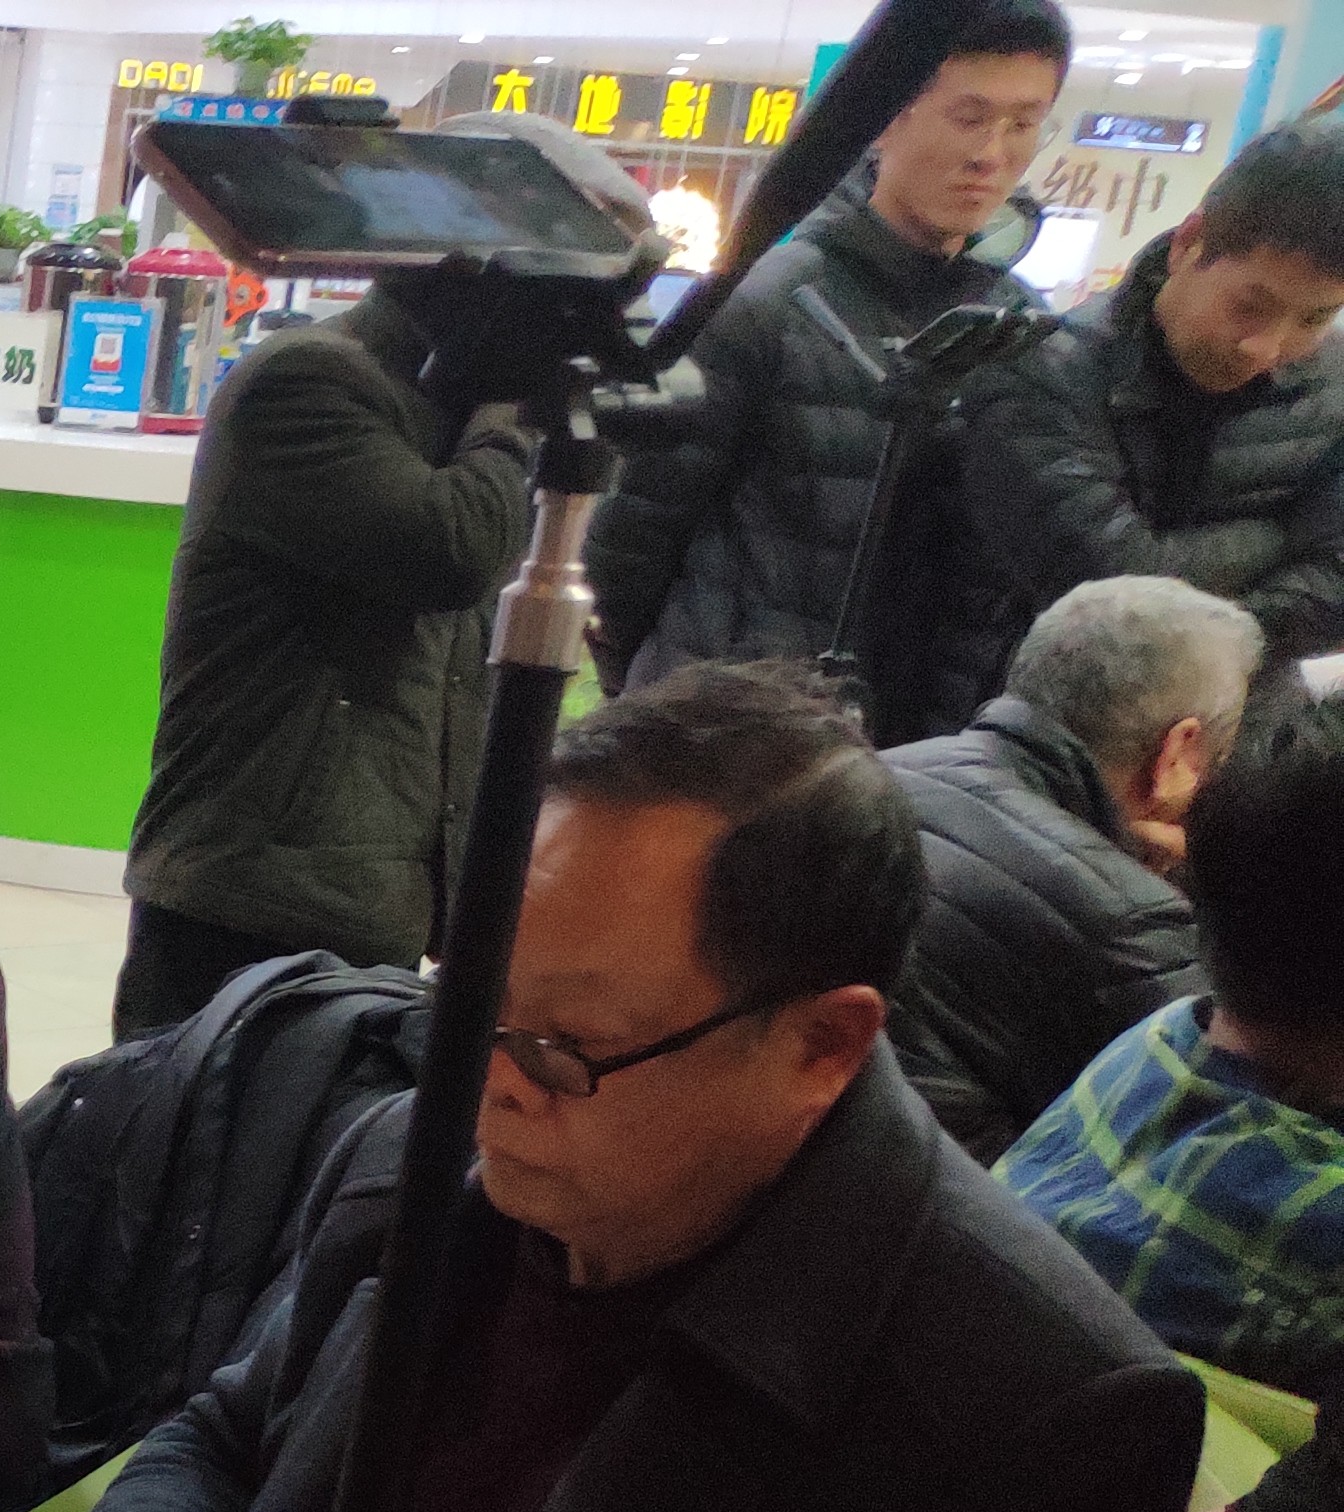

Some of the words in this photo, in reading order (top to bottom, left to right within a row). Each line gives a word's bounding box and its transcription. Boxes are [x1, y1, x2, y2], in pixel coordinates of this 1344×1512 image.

[118, 58, 204, 93] DADI
[491, 68, 799, 145] 大地影院
